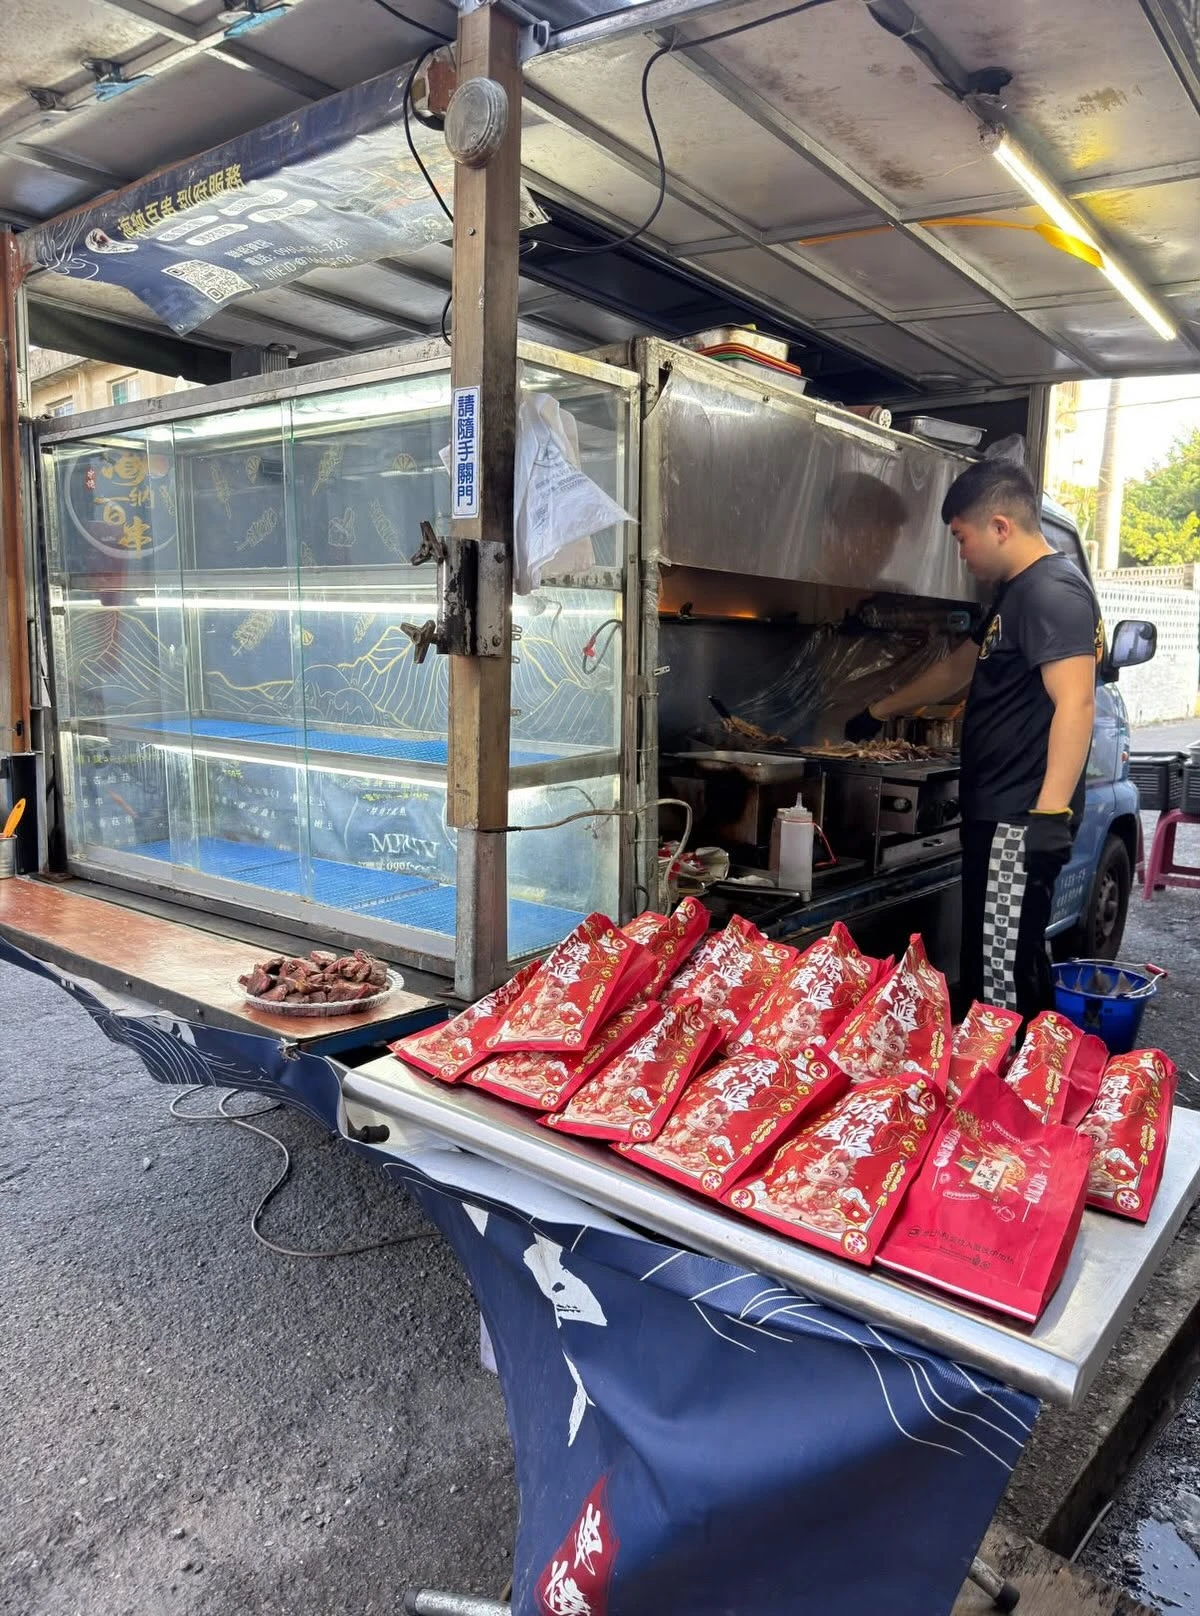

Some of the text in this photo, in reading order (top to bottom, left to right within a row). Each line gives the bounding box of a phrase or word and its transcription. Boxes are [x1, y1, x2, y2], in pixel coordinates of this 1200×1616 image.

[176, 163, 245, 212] 到府服務
[457, 394, 475, 507] 請隨手關門
